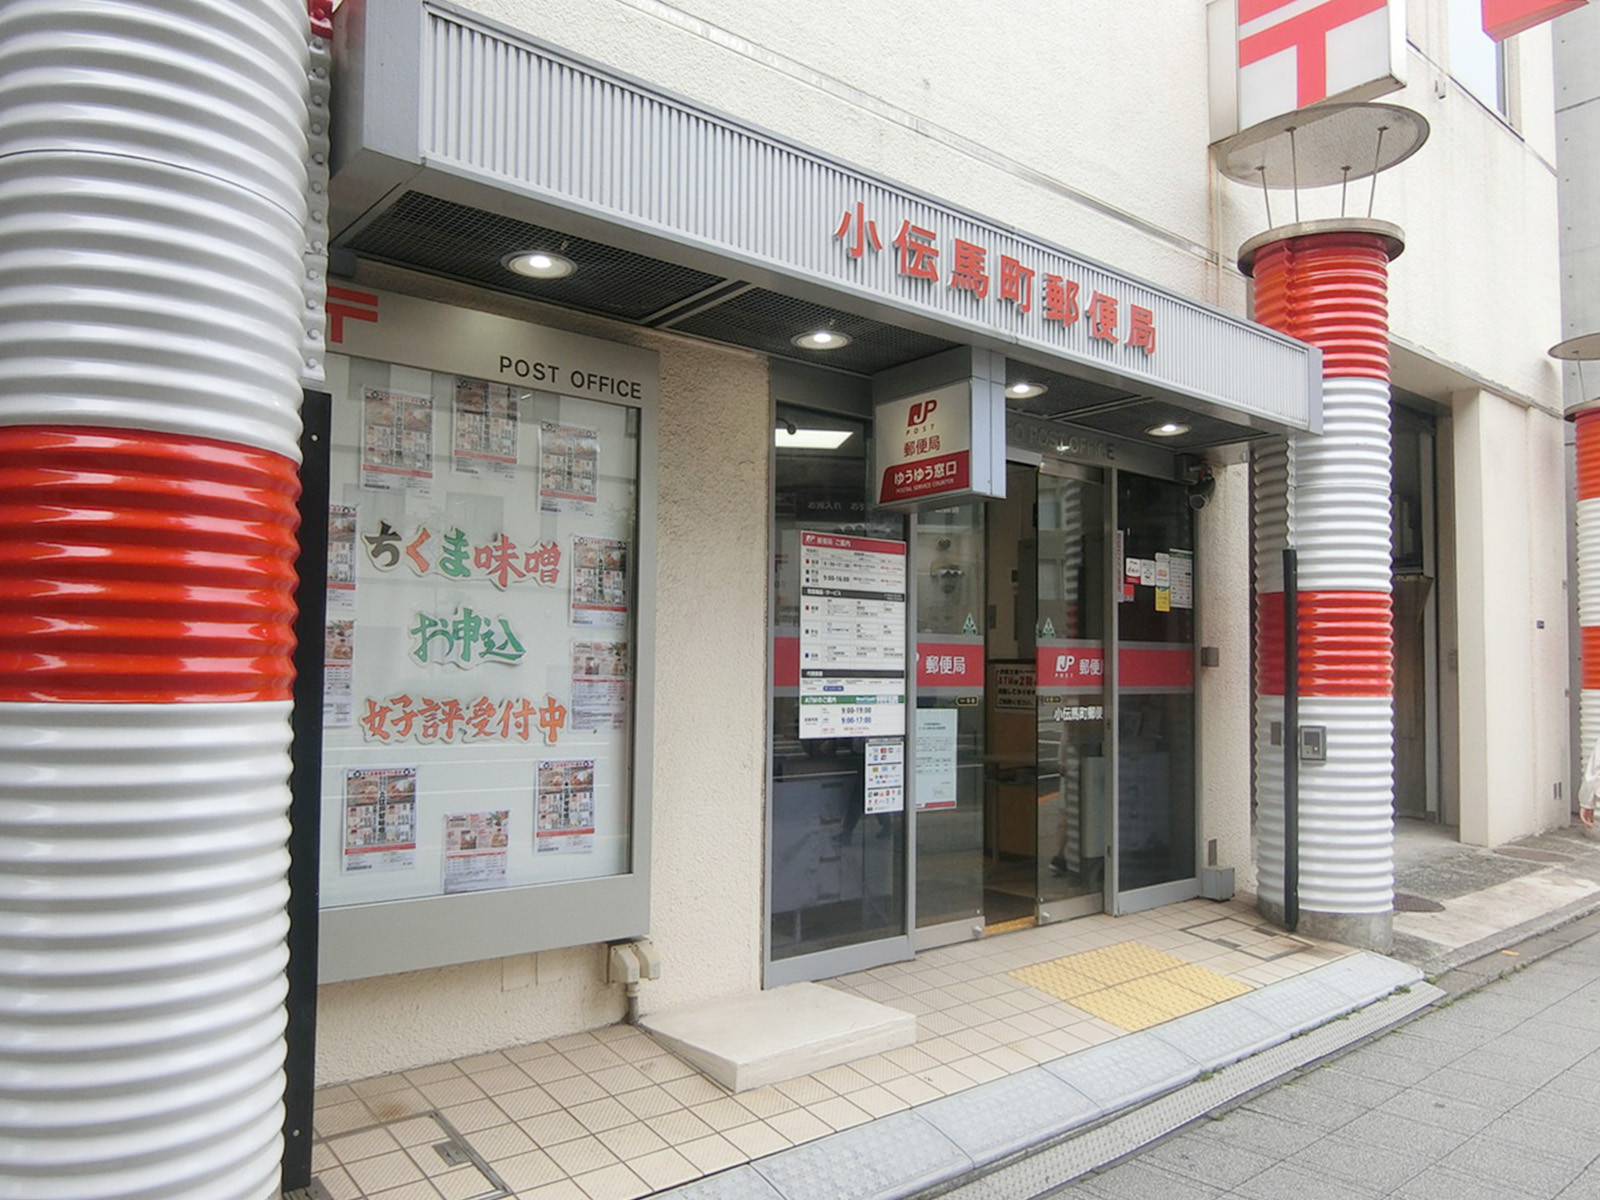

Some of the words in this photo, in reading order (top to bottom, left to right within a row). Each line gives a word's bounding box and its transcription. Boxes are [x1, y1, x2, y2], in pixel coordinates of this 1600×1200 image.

[834, 201, 1157, 355] 小伝馬町郵便局
[499, 356, 560, 384] POST
[570, 370, 642, 399] OFFICE
[908, 399, 938, 427] JP
[905, 423, 935, 436] POST
[904, 435, 941, 458] 郵便局
[1069, 436, 1115, 460] OFFICE
[894, 460, 957, 486] ゆうゆう窓口
[366, 520, 562, 589] ちくま味噌
[409, 607, 526, 662] お申込
[925, 655, 966, 675] 郵便局
[1078, 658, 1104, 675] 郵便
[362, 694, 567, 745] 好評受付中
